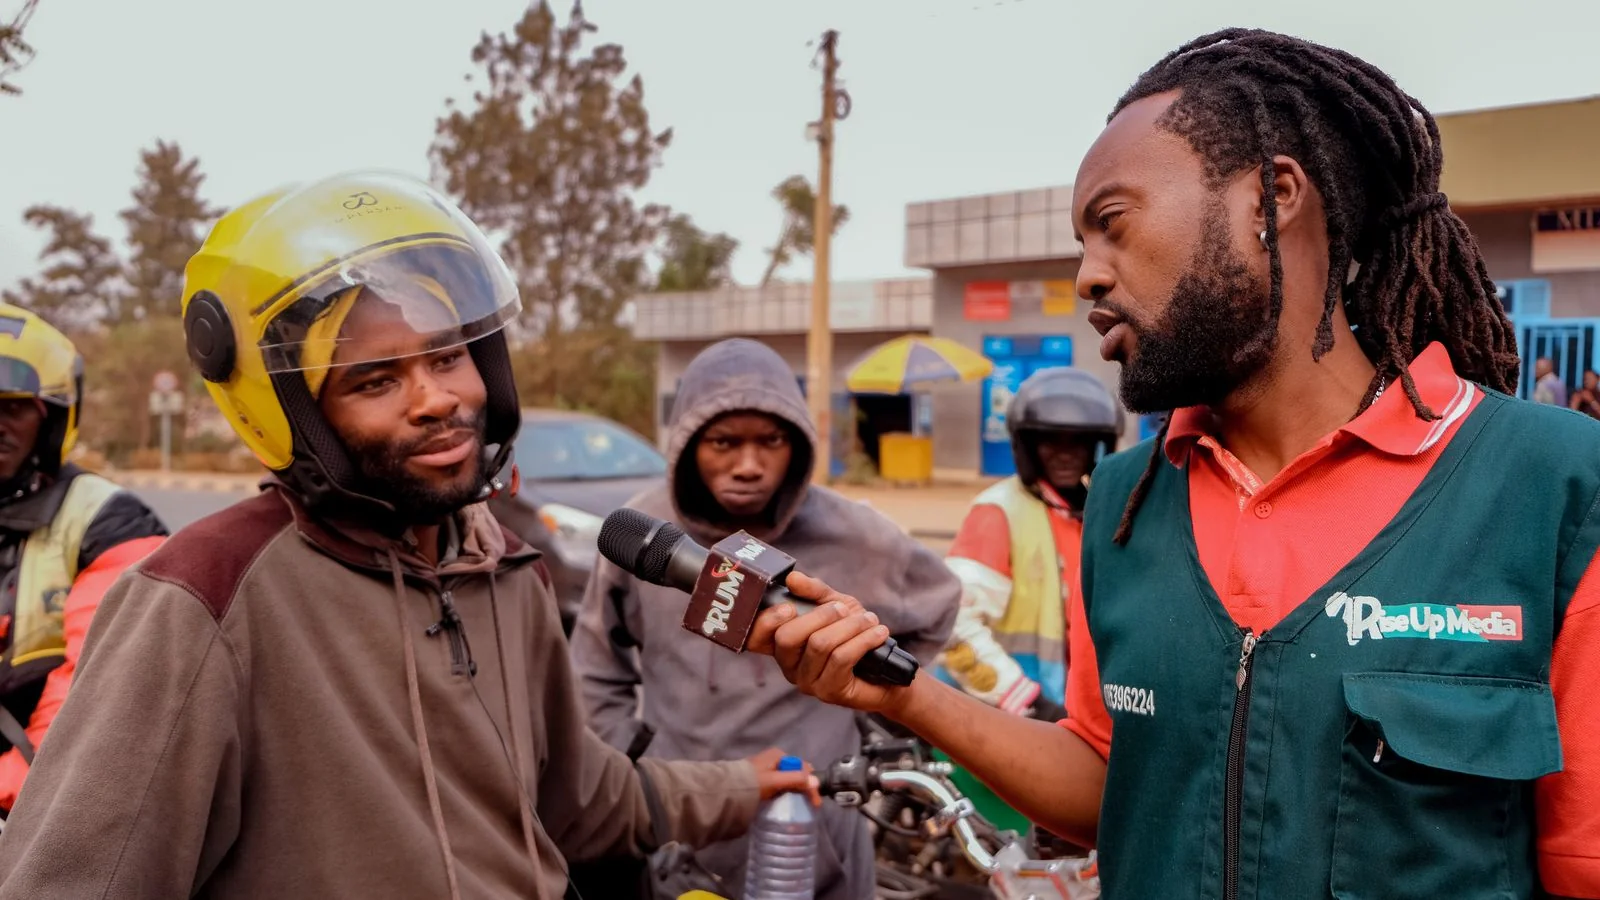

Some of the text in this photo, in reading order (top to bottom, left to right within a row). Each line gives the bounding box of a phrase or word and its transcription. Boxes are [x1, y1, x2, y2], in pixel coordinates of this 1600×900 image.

[705, 570, 746, 627] RUM
[1352, 595, 1516, 640] Rise Up Media
